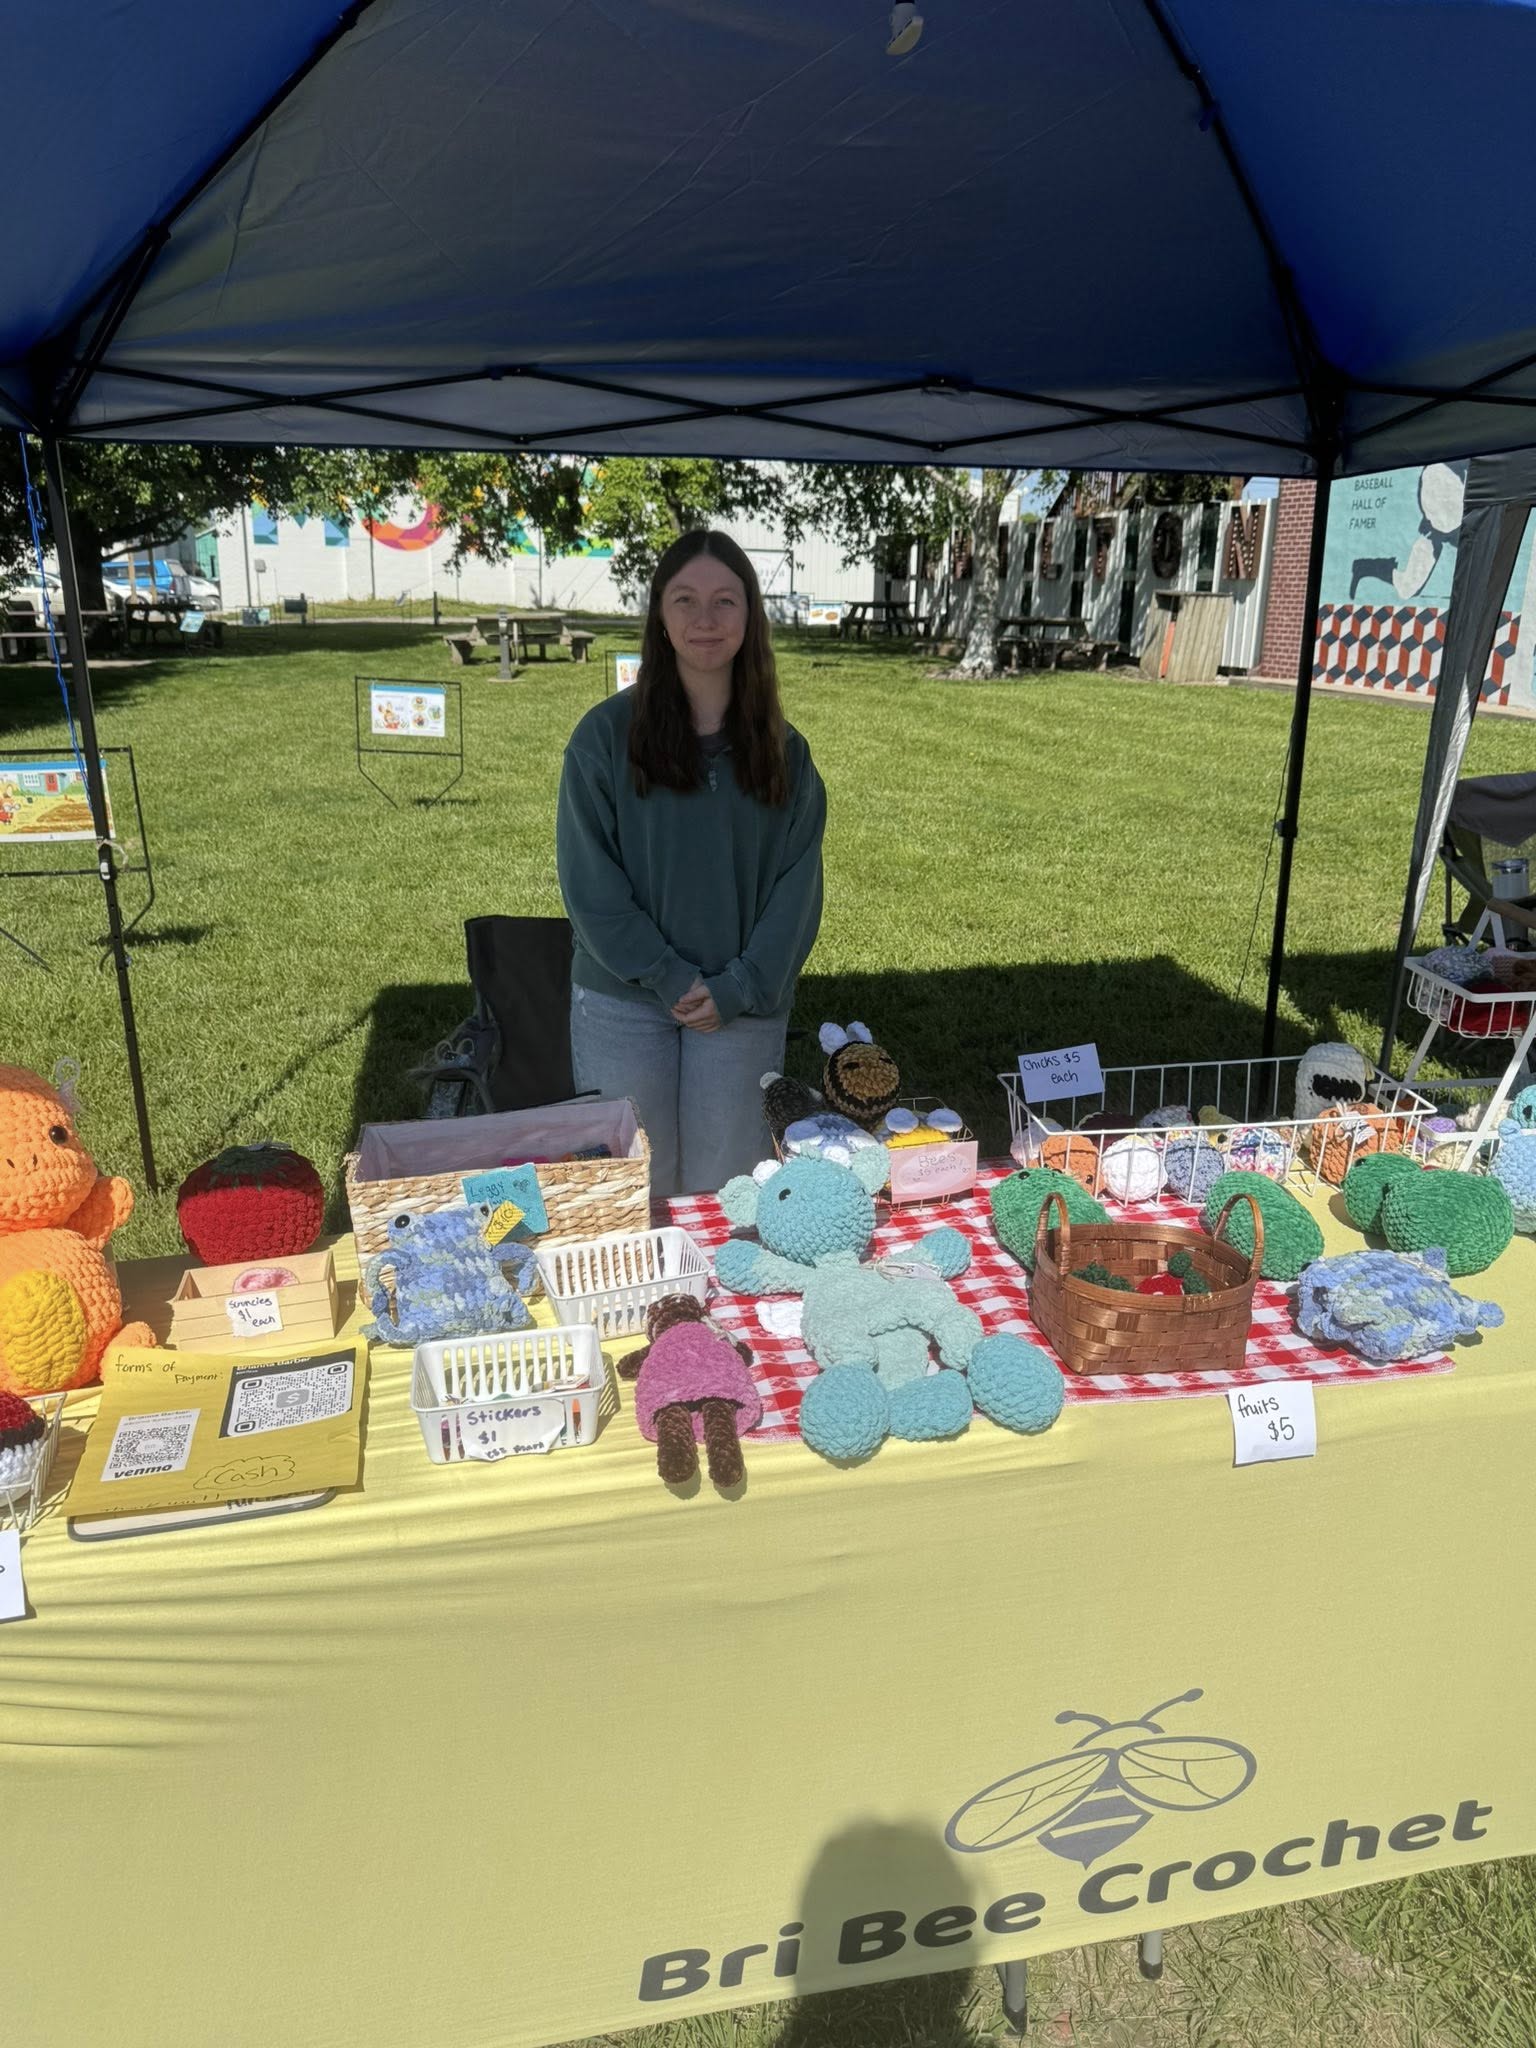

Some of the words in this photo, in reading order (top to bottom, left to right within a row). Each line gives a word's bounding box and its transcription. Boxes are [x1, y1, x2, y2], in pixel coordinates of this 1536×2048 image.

[1354, 477, 1393, 491] BASEBALL
[1351, 499, 1372, 510] HALL
[1374, 497, 1387, 509] OF
[1348, 517, 1376, 530] FAMER
[1064, 1051, 1081, 1064] $5
[1051, 1069, 1079, 1085] each
[918, 1152, 957, 1169] Bees
[252, 1315, 276, 1327] each
[115, 1353, 153, 1373] forms
[162, 1361, 176, 1373] of
[1237, 1393, 1280, 1418] fruits
[466, 1405, 542, 1426] Stickers
[1267, 1416, 1295, 1442] $5
[114, 1463, 173, 1479] venmo
[638, 1922, 804, 2002] Bri
[837, 1891, 1046, 1966] Bee
[1077, 1799, 1493, 1915] Crochet
